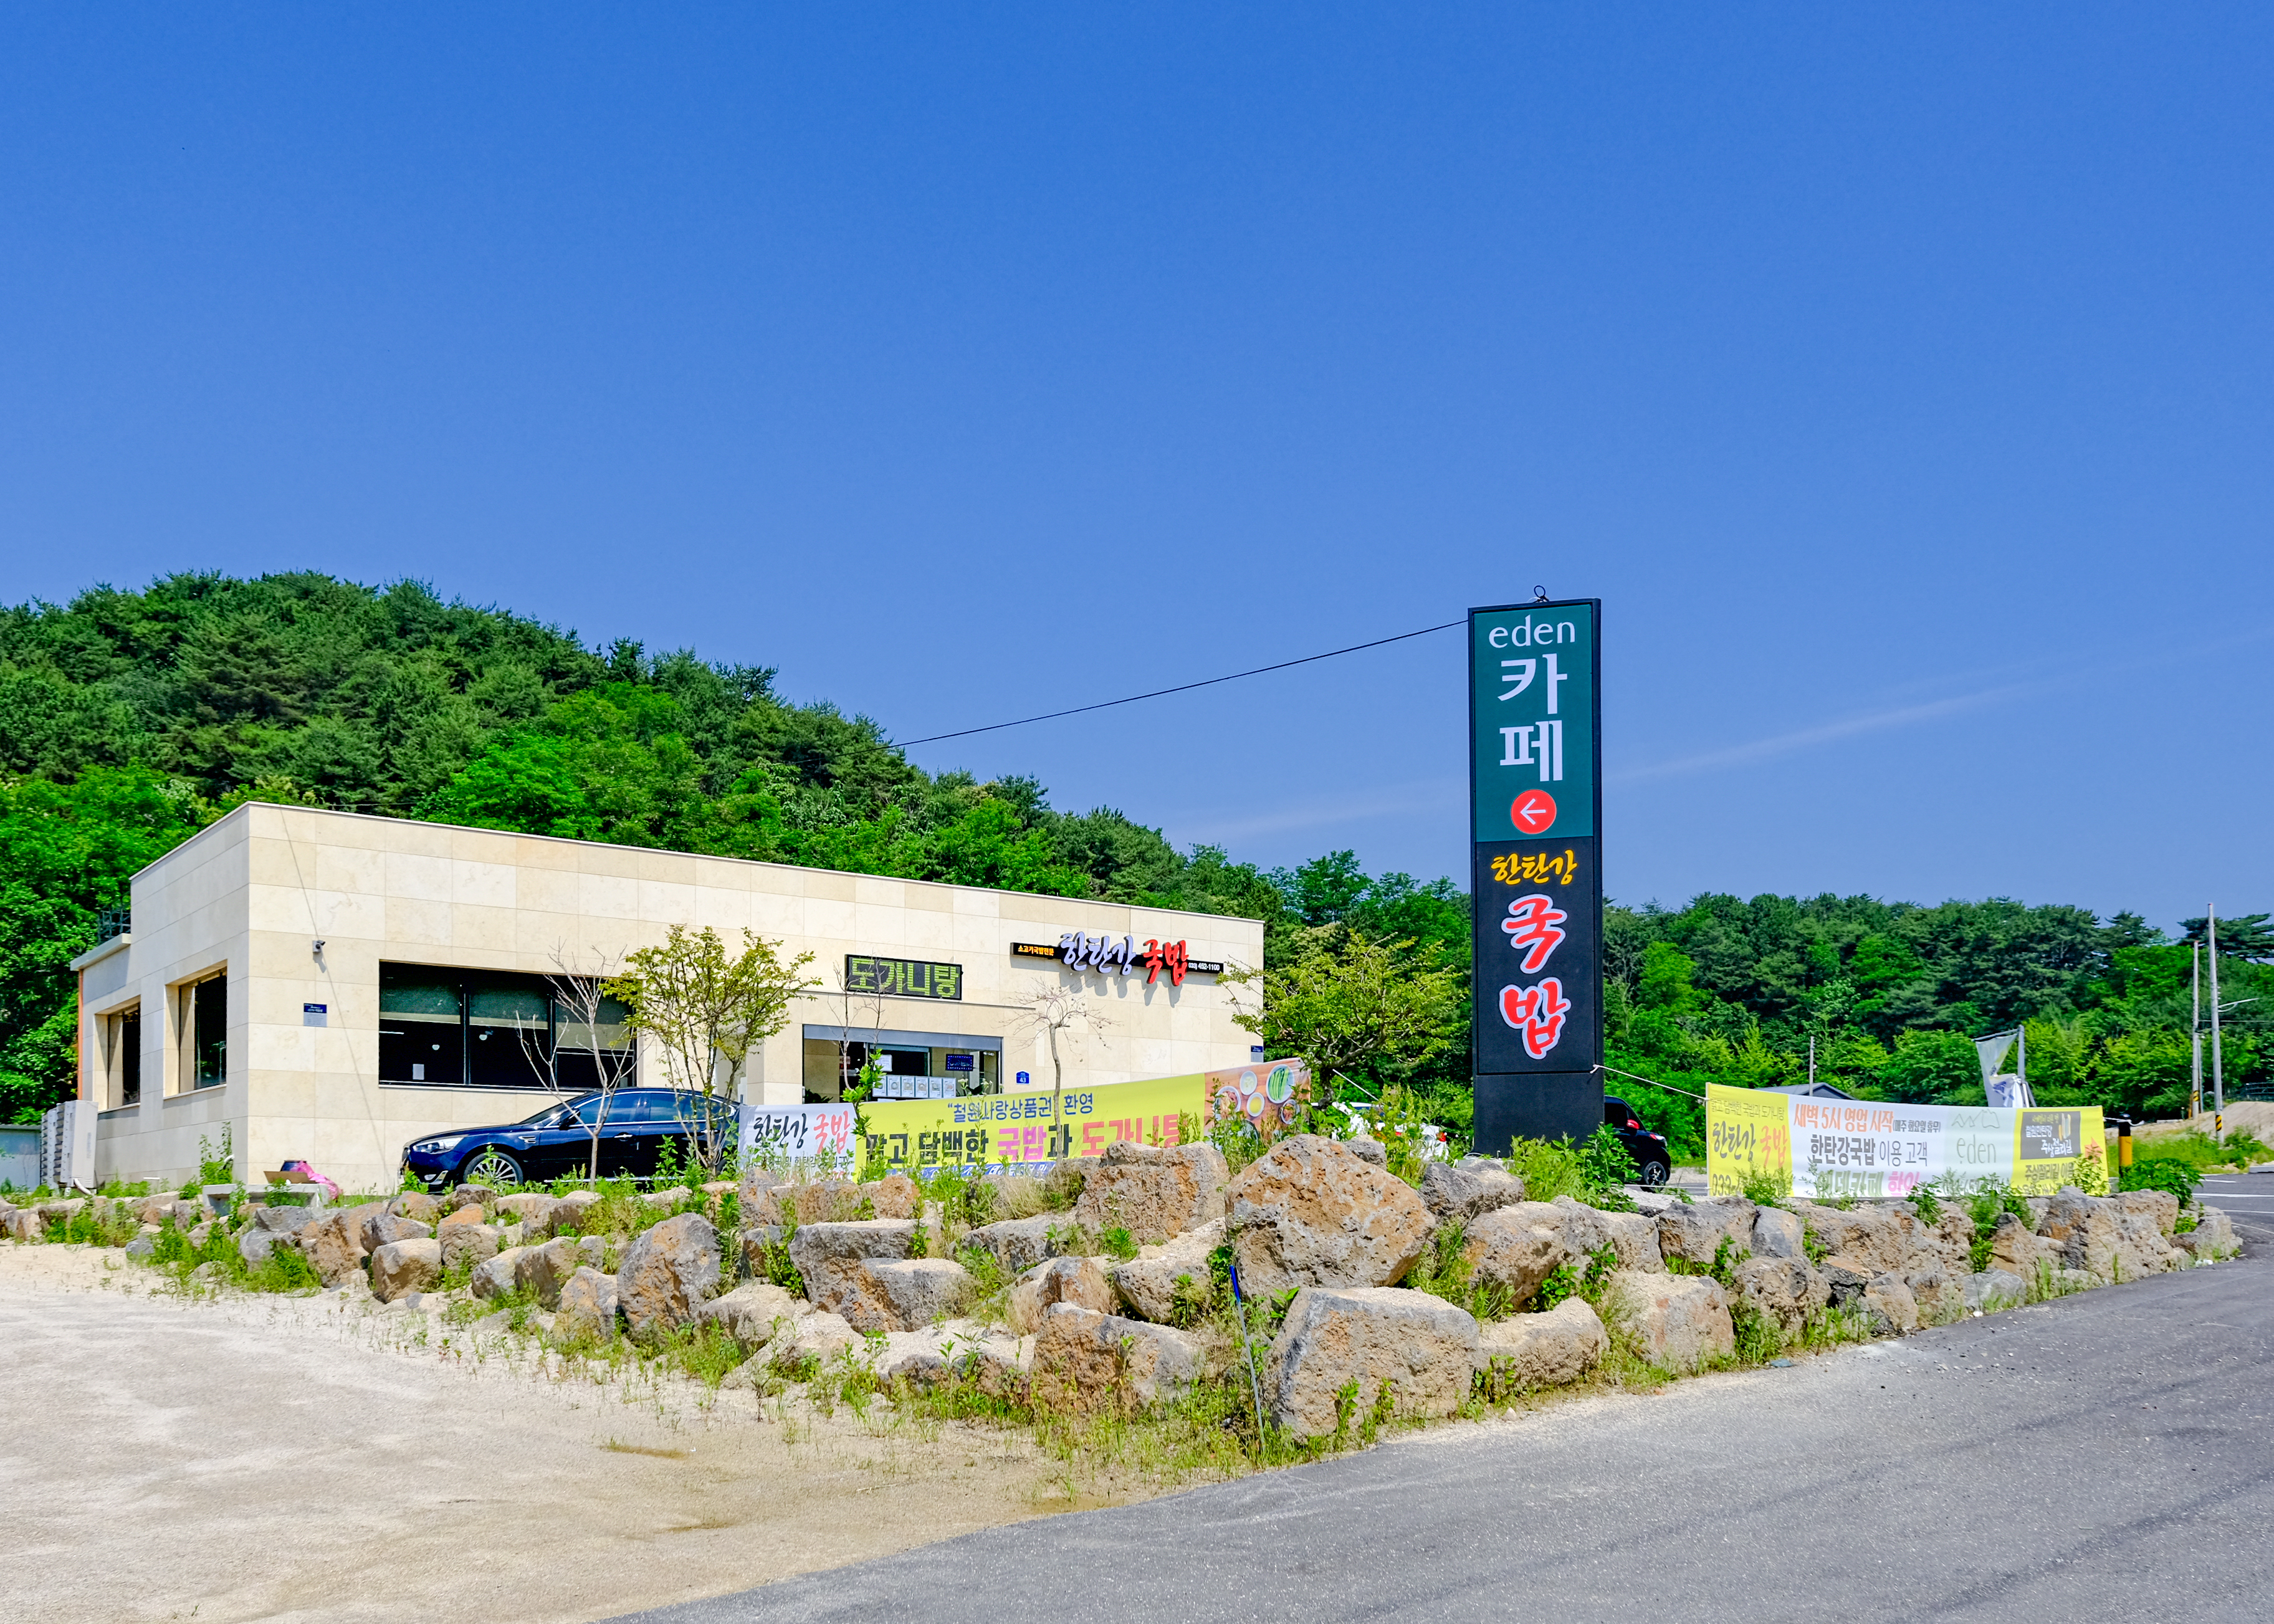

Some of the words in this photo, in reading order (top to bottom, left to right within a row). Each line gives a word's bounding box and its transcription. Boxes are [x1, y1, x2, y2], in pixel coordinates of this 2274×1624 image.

[1489, 614, 1575, 648] eden
[1498, 653, 1567, 781] 카페
[1491, 849, 1577, 885] 한탄강
[1018, 945, 1054, 956] 소고기국밥전문
[1060, 932, 1136, 975] 한탄강
[1143, 939, 1189, 986] 국밥
[850, 958, 960, 998] 도가니탕
[1499, 894, 1571, 1059] 국밥
[1064, 1092, 1093, 1115] 환영
[1742, 1102, 1760, 1118] 국밥과
[1761, 1106, 1785, 1120] 도가니탕
[1794, 1104, 1819, 1129] 새벽
[1822, 1107, 1842, 1130] 5시
[1844, 1107, 1868, 1132] 영업
[1870, 1110, 1893, 1133] 시작
[1908, 1120, 1926, 1133] 화요일
[753, 1113, 808, 1149] 한탄강
[813, 1111, 850, 1154] 국밥
[919, 1129, 989, 1164] 담백한
[998, 1124, 1073, 1161] 국밥과
[1713, 1120, 1756, 1162] 한탄강
[1760, 1125, 1788, 1168] 국밥
[1810, 1134, 1876, 1166] 한탄강국밥
[1880, 1140, 1902, 1167] 이용
[1905, 1142, 1928, 1167] 고객
[1956, 1134, 1996, 1164] eden
